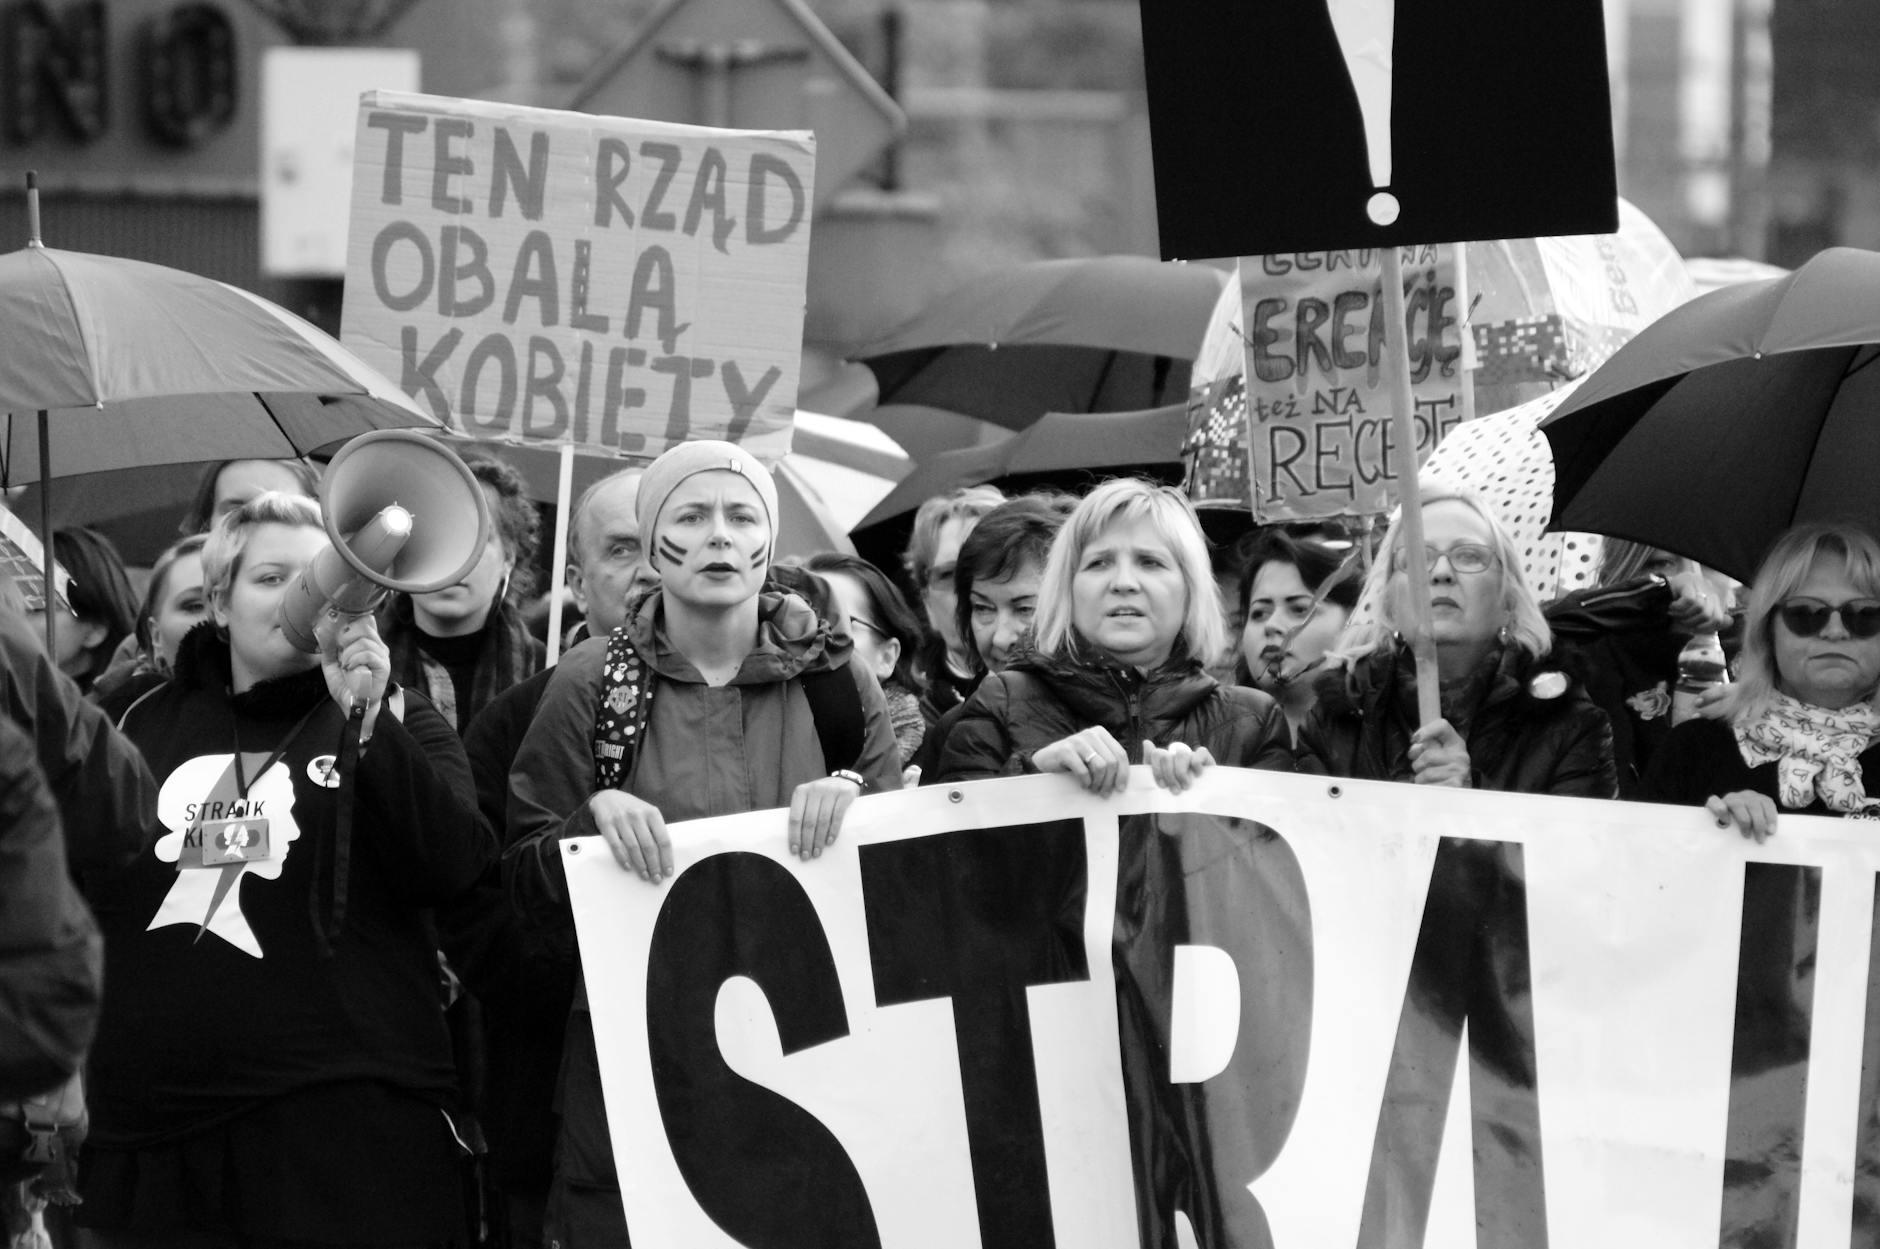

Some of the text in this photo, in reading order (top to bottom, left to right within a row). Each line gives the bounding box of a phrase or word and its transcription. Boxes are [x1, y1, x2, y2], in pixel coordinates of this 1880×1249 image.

[367, 111, 806, 256] TEN RZĄD
[371, 220, 692, 355] OBALĄ
[400, 325, 783, 455] KOBIETY
[1312, 386, 1366, 416] NA
